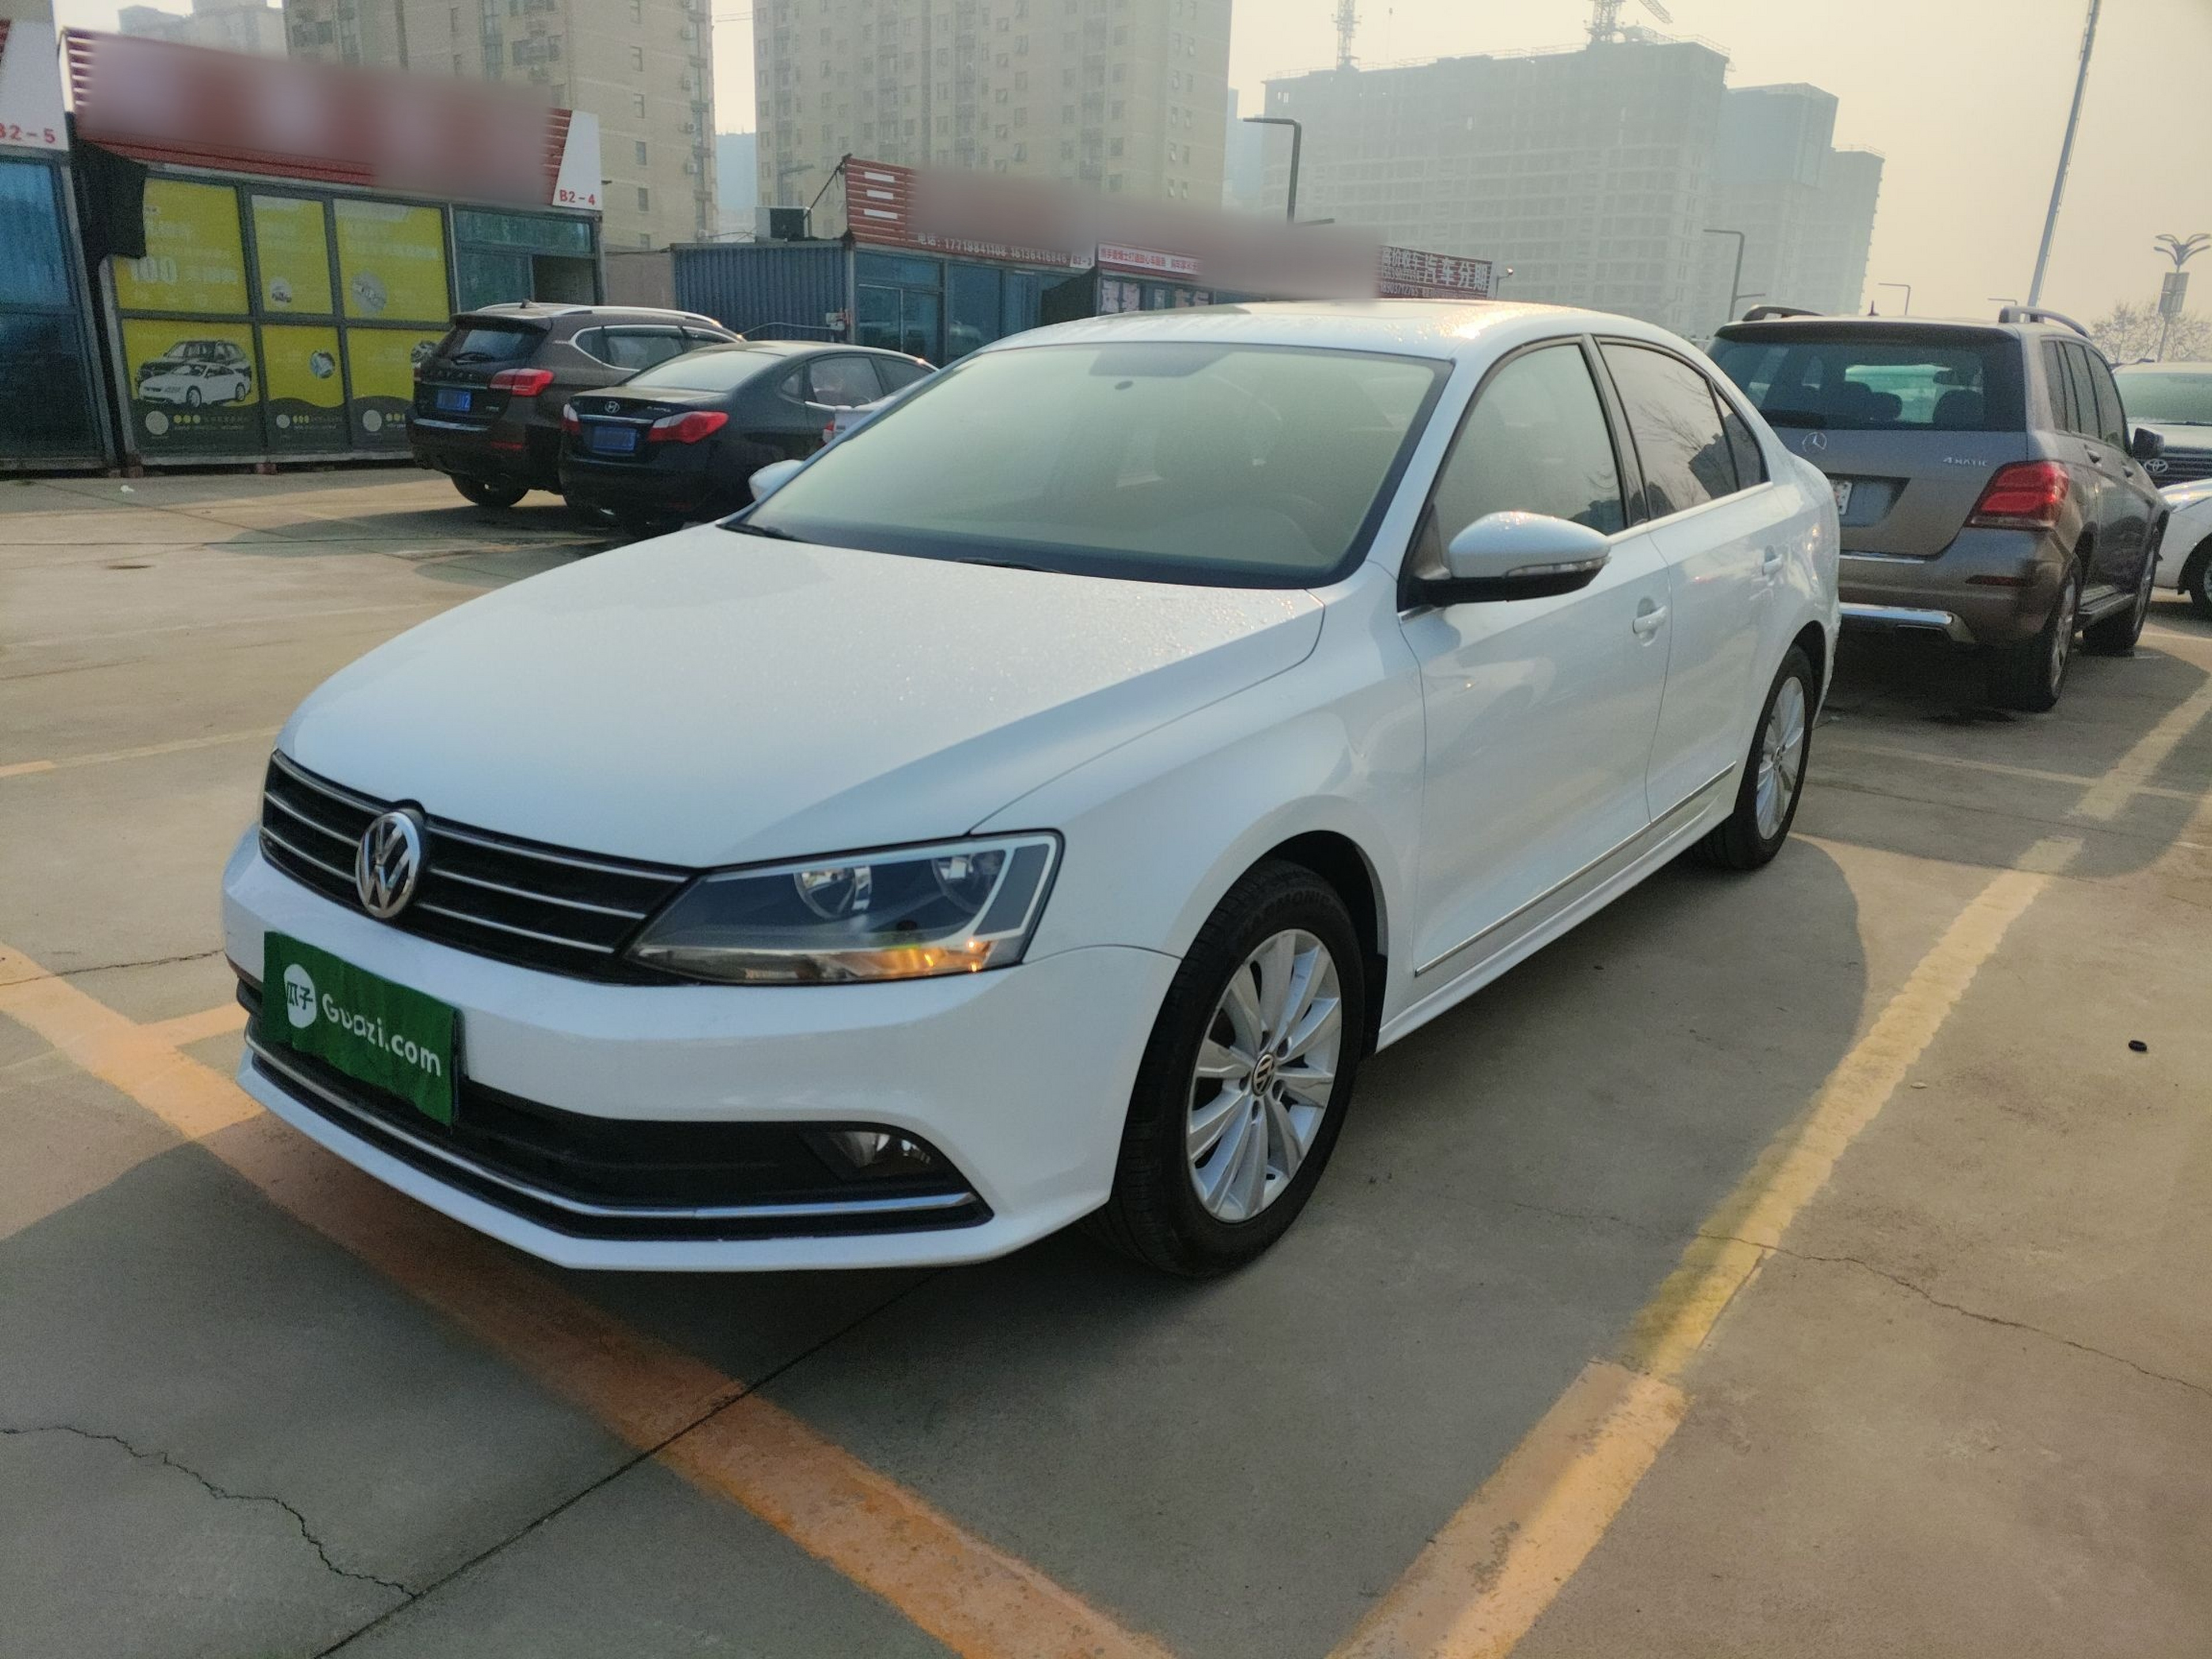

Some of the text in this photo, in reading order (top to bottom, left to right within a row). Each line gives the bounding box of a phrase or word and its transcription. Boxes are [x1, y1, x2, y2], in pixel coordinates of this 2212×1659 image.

[559, 190, 595, 206] B2-4
[1424, 254, 1490, 291] 汽车分期
[1942, 456, 1988, 467] 4MATIC
[286, 980, 442, 1077] 瓜子 Guazi.com
